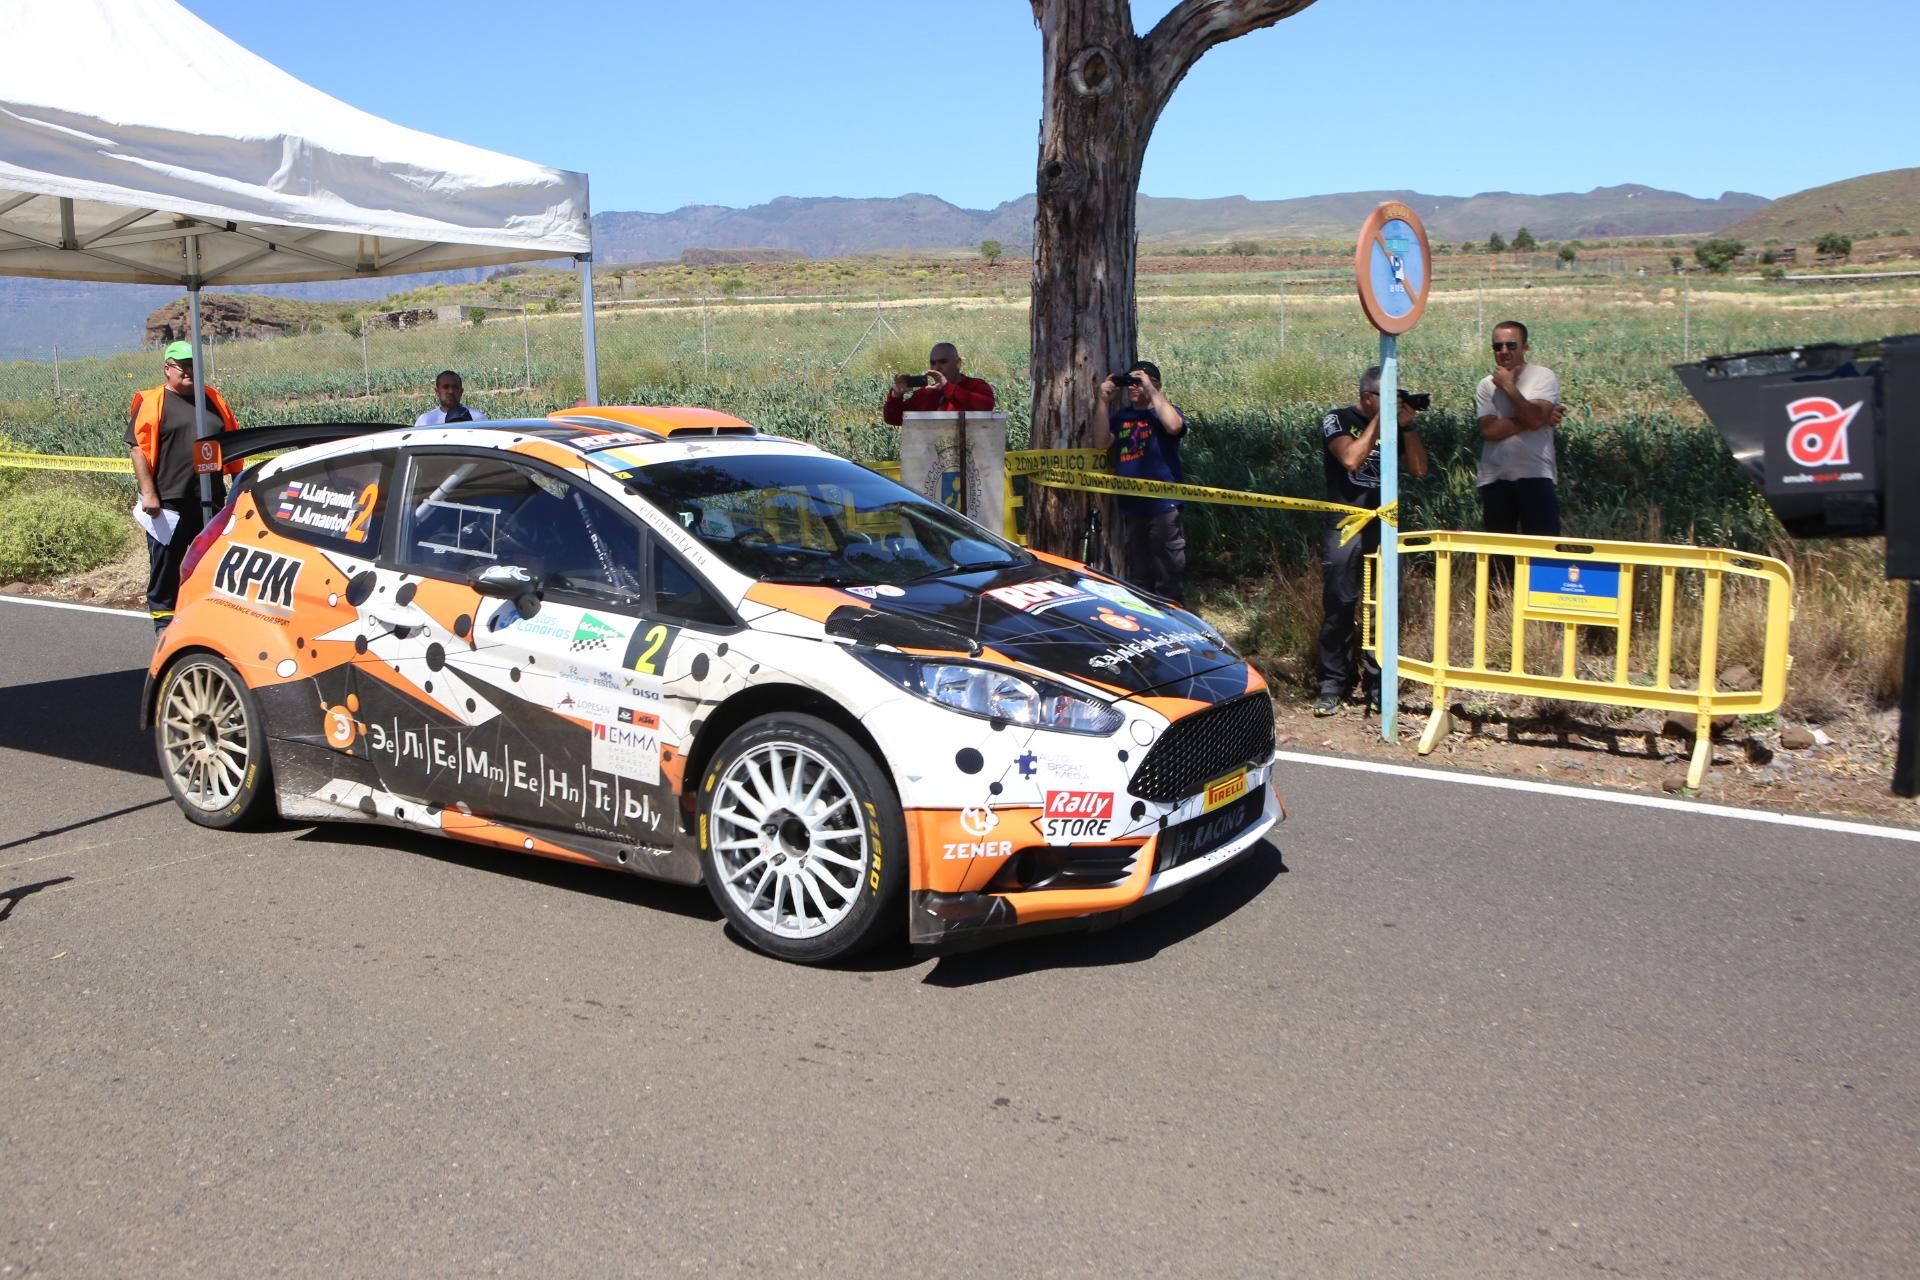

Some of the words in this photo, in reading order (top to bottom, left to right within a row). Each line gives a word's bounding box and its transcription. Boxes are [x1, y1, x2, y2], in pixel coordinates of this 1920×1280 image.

[198, 463, 218, 473] ZENER
[1015, 456, 1039, 471] ZONA
[1040, 454, 1085, 470] PUBLICO
[299, 483, 356, 508] A.Lukyanuk
[344, 483, 379, 544] 2
[214, 544, 303, 608] RPM
[516, 618, 572, 640] Canarias
[634, 623, 668, 676] 2
[609, 726, 659, 754] EMMA
[1208, 774, 1245, 806] PIRELLI
[1050, 791, 1110, 819] Rally
[1046, 818, 1111, 837] STORE
[943, 842, 1013, 860] ZENER
